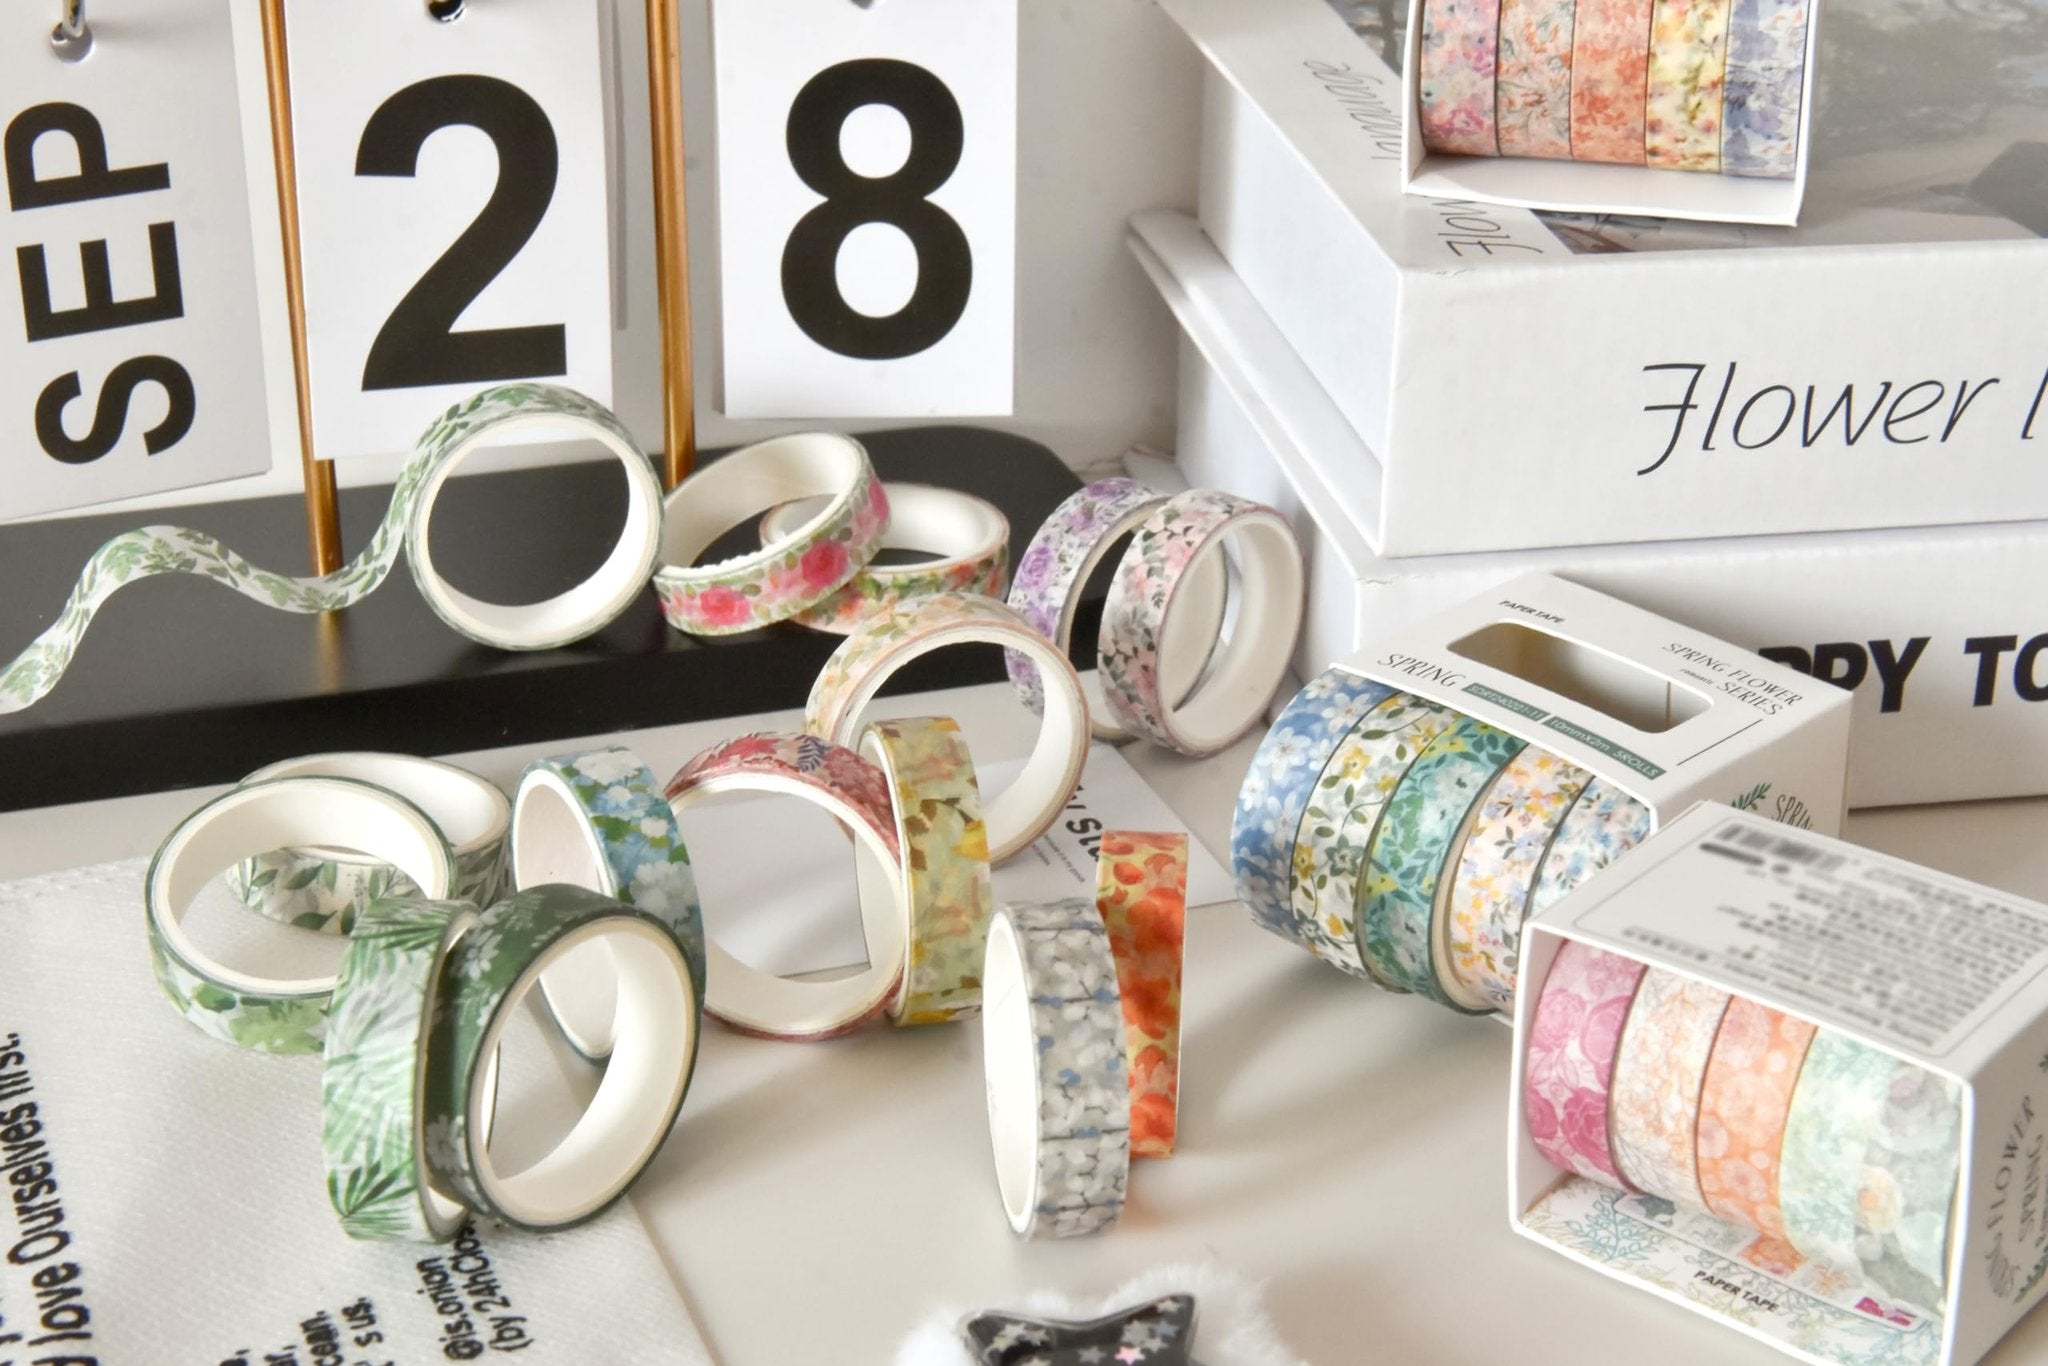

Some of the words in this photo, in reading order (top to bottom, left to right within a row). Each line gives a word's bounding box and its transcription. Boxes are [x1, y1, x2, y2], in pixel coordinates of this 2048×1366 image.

[354, 73, 568, 392] 2
[780, 57, 973, 361] 8
[4, 101, 196, 464] SEP
[1637, 361, 2000, 476] Flower
[1499, 600, 1537, 614] PAPER
[1534, 610, 1566, 623] TAPE
[1376, 652, 1467, 687] SPRING
[1662, 642, 1731, 673] SPRING
[1728, 669, 1804, 706] FLOWER
[1716, 681, 1784, 716] SERIES
[27, 1261, 92, 1347] love
[1693, 1270, 1742, 1296] PAPER
[1741, 1289, 1780, 1314] TAPE
[487, 1315, 535, 1352] (by
